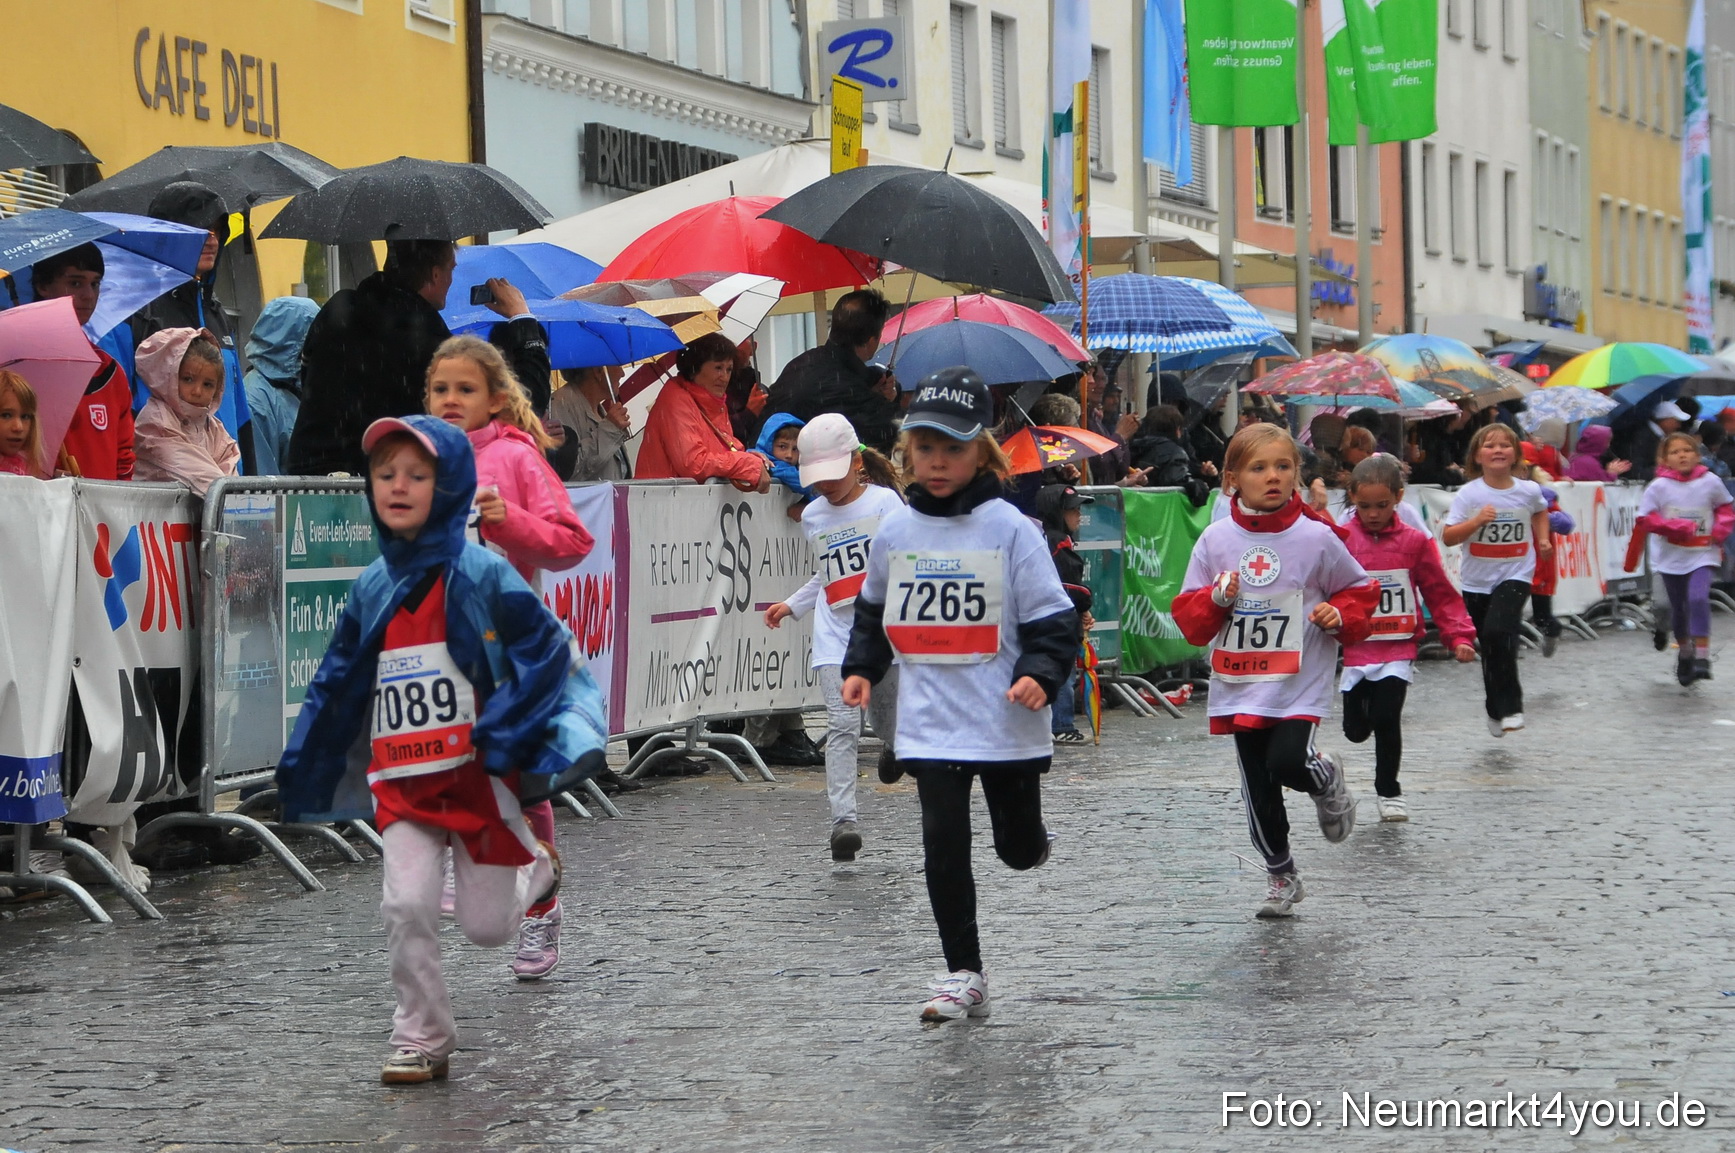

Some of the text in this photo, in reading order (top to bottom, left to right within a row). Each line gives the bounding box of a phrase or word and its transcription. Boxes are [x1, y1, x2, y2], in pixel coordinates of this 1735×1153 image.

[1403, 58, 1434, 71] leben.
[134, 26, 280, 140] CAFE DELI
[916, 386, 975, 409] MELANIE
[1478, 522, 1524, 543] 7320
[651, 540, 714, 586] RECHTS
[915, 559, 961, 571] BOCK
[1242, 547, 1279, 564] DEUTSCHES
[1258, 568, 1279, 584] KREUZ
[899, 581, 986, 622] 7265
[1222, 615, 1290, 649] 7157
[733, 636, 790, 692] Meier
[1223, 657, 1268, 671] Daria
[375, 677, 457, 733] 7089
[385, 738, 444, 762] Tamara
